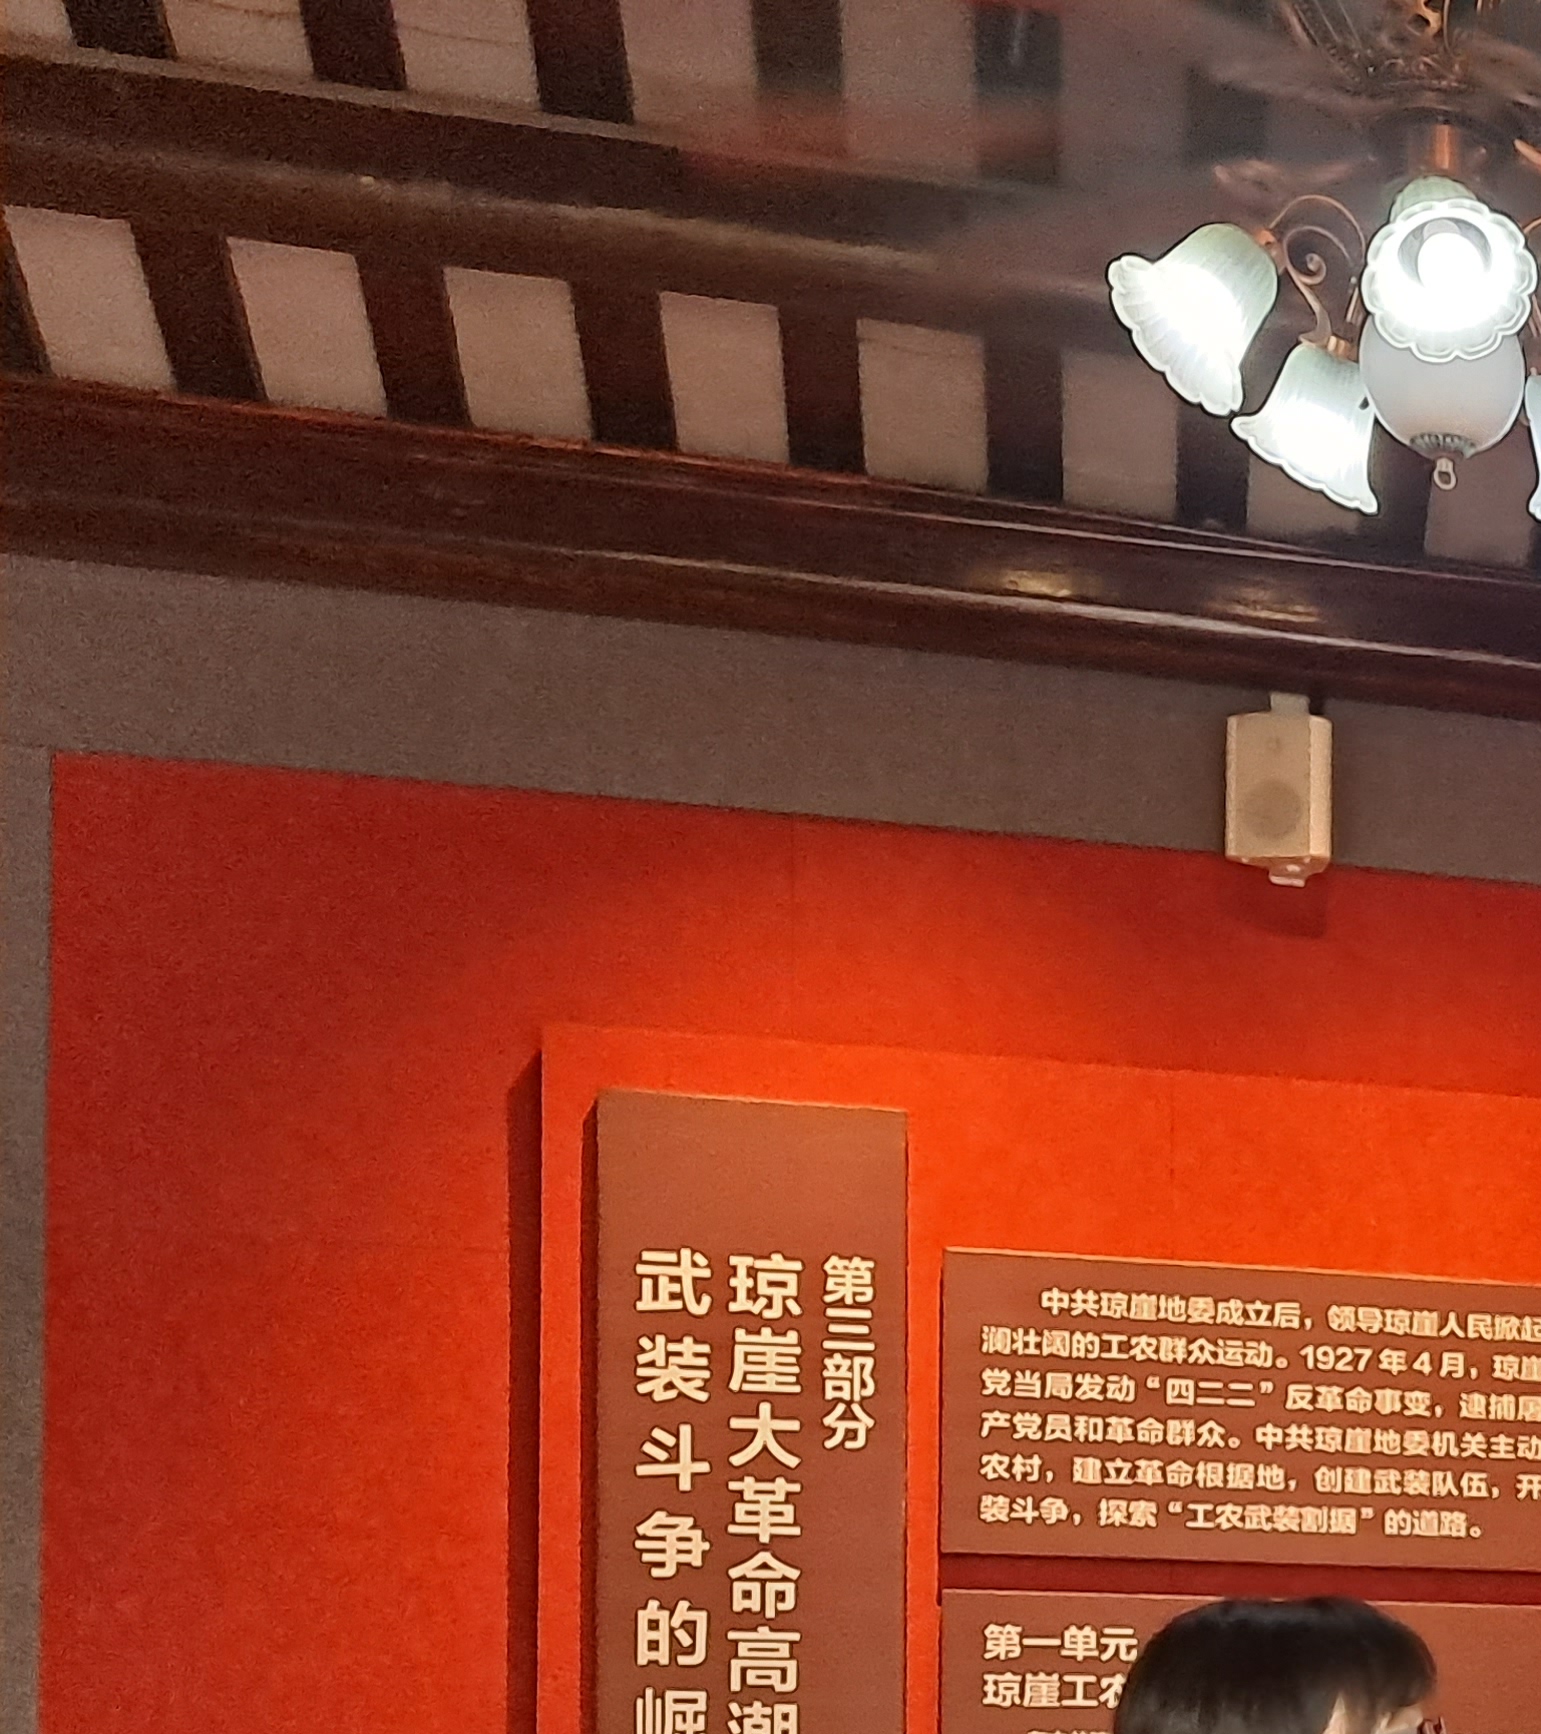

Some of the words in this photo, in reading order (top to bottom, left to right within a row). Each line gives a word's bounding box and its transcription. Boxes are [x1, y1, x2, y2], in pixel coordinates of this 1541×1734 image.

[821, 1253, 876, 1450] 第三部分
[979, 1493, 1484, 1539] 装斗争，探索“工农武装割据”的道路。
[982, 1622, 1140, 1662] 第一单元
